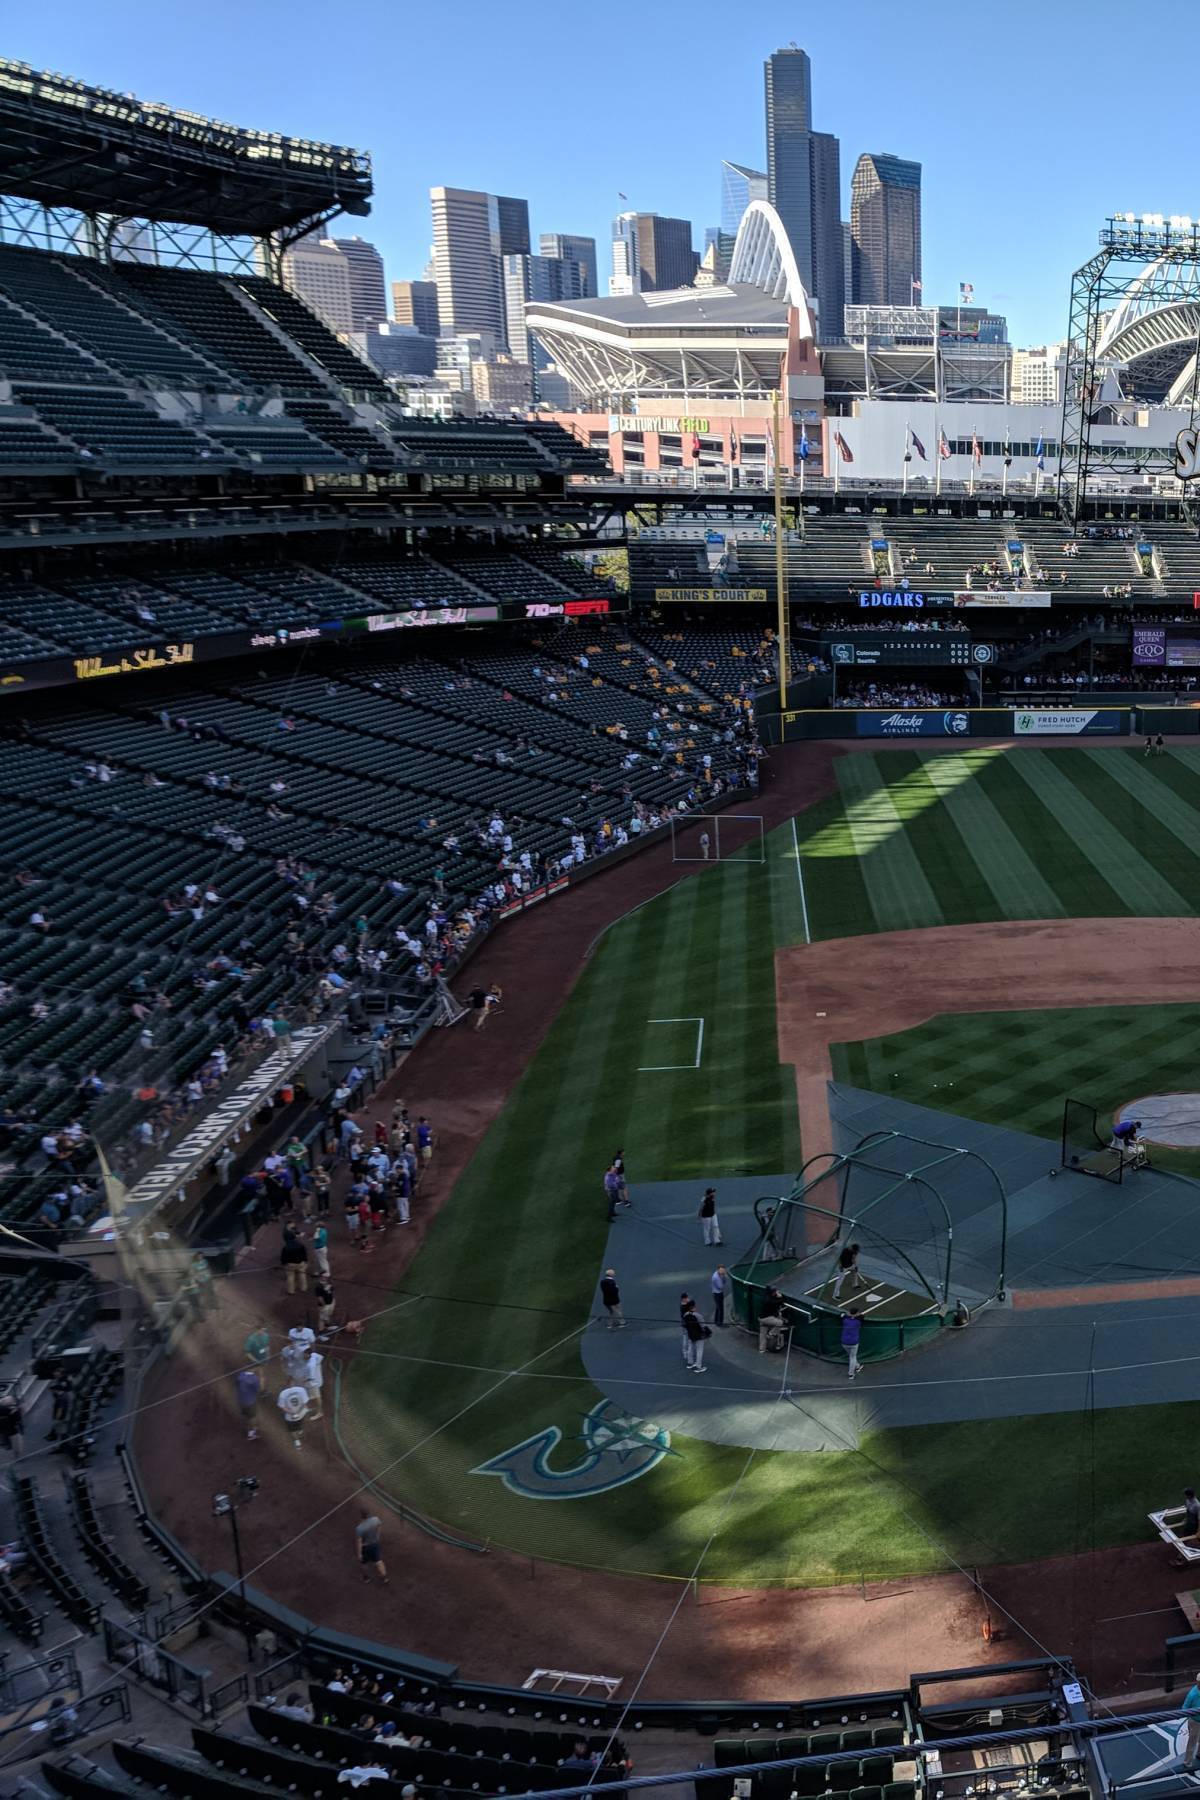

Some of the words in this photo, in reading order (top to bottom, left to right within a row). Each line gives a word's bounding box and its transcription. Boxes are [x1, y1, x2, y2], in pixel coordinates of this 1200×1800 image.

[620, 416, 680, 432] CENTURYLINK
[681, 417, 709, 433] FIELD
[672, 590, 710, 600] KING'S
[713, 590, 750, 600] COURT
[525, 603, 550, 617] 710
[564, 600, 609, 616] ESPN
[881, 714, 924, 726] Alaska
[218, 1094, 255, 1110] TO
[168, 1110, 241, 1158] SAFECO
[126, 1162, 191, 1203] FIELD
